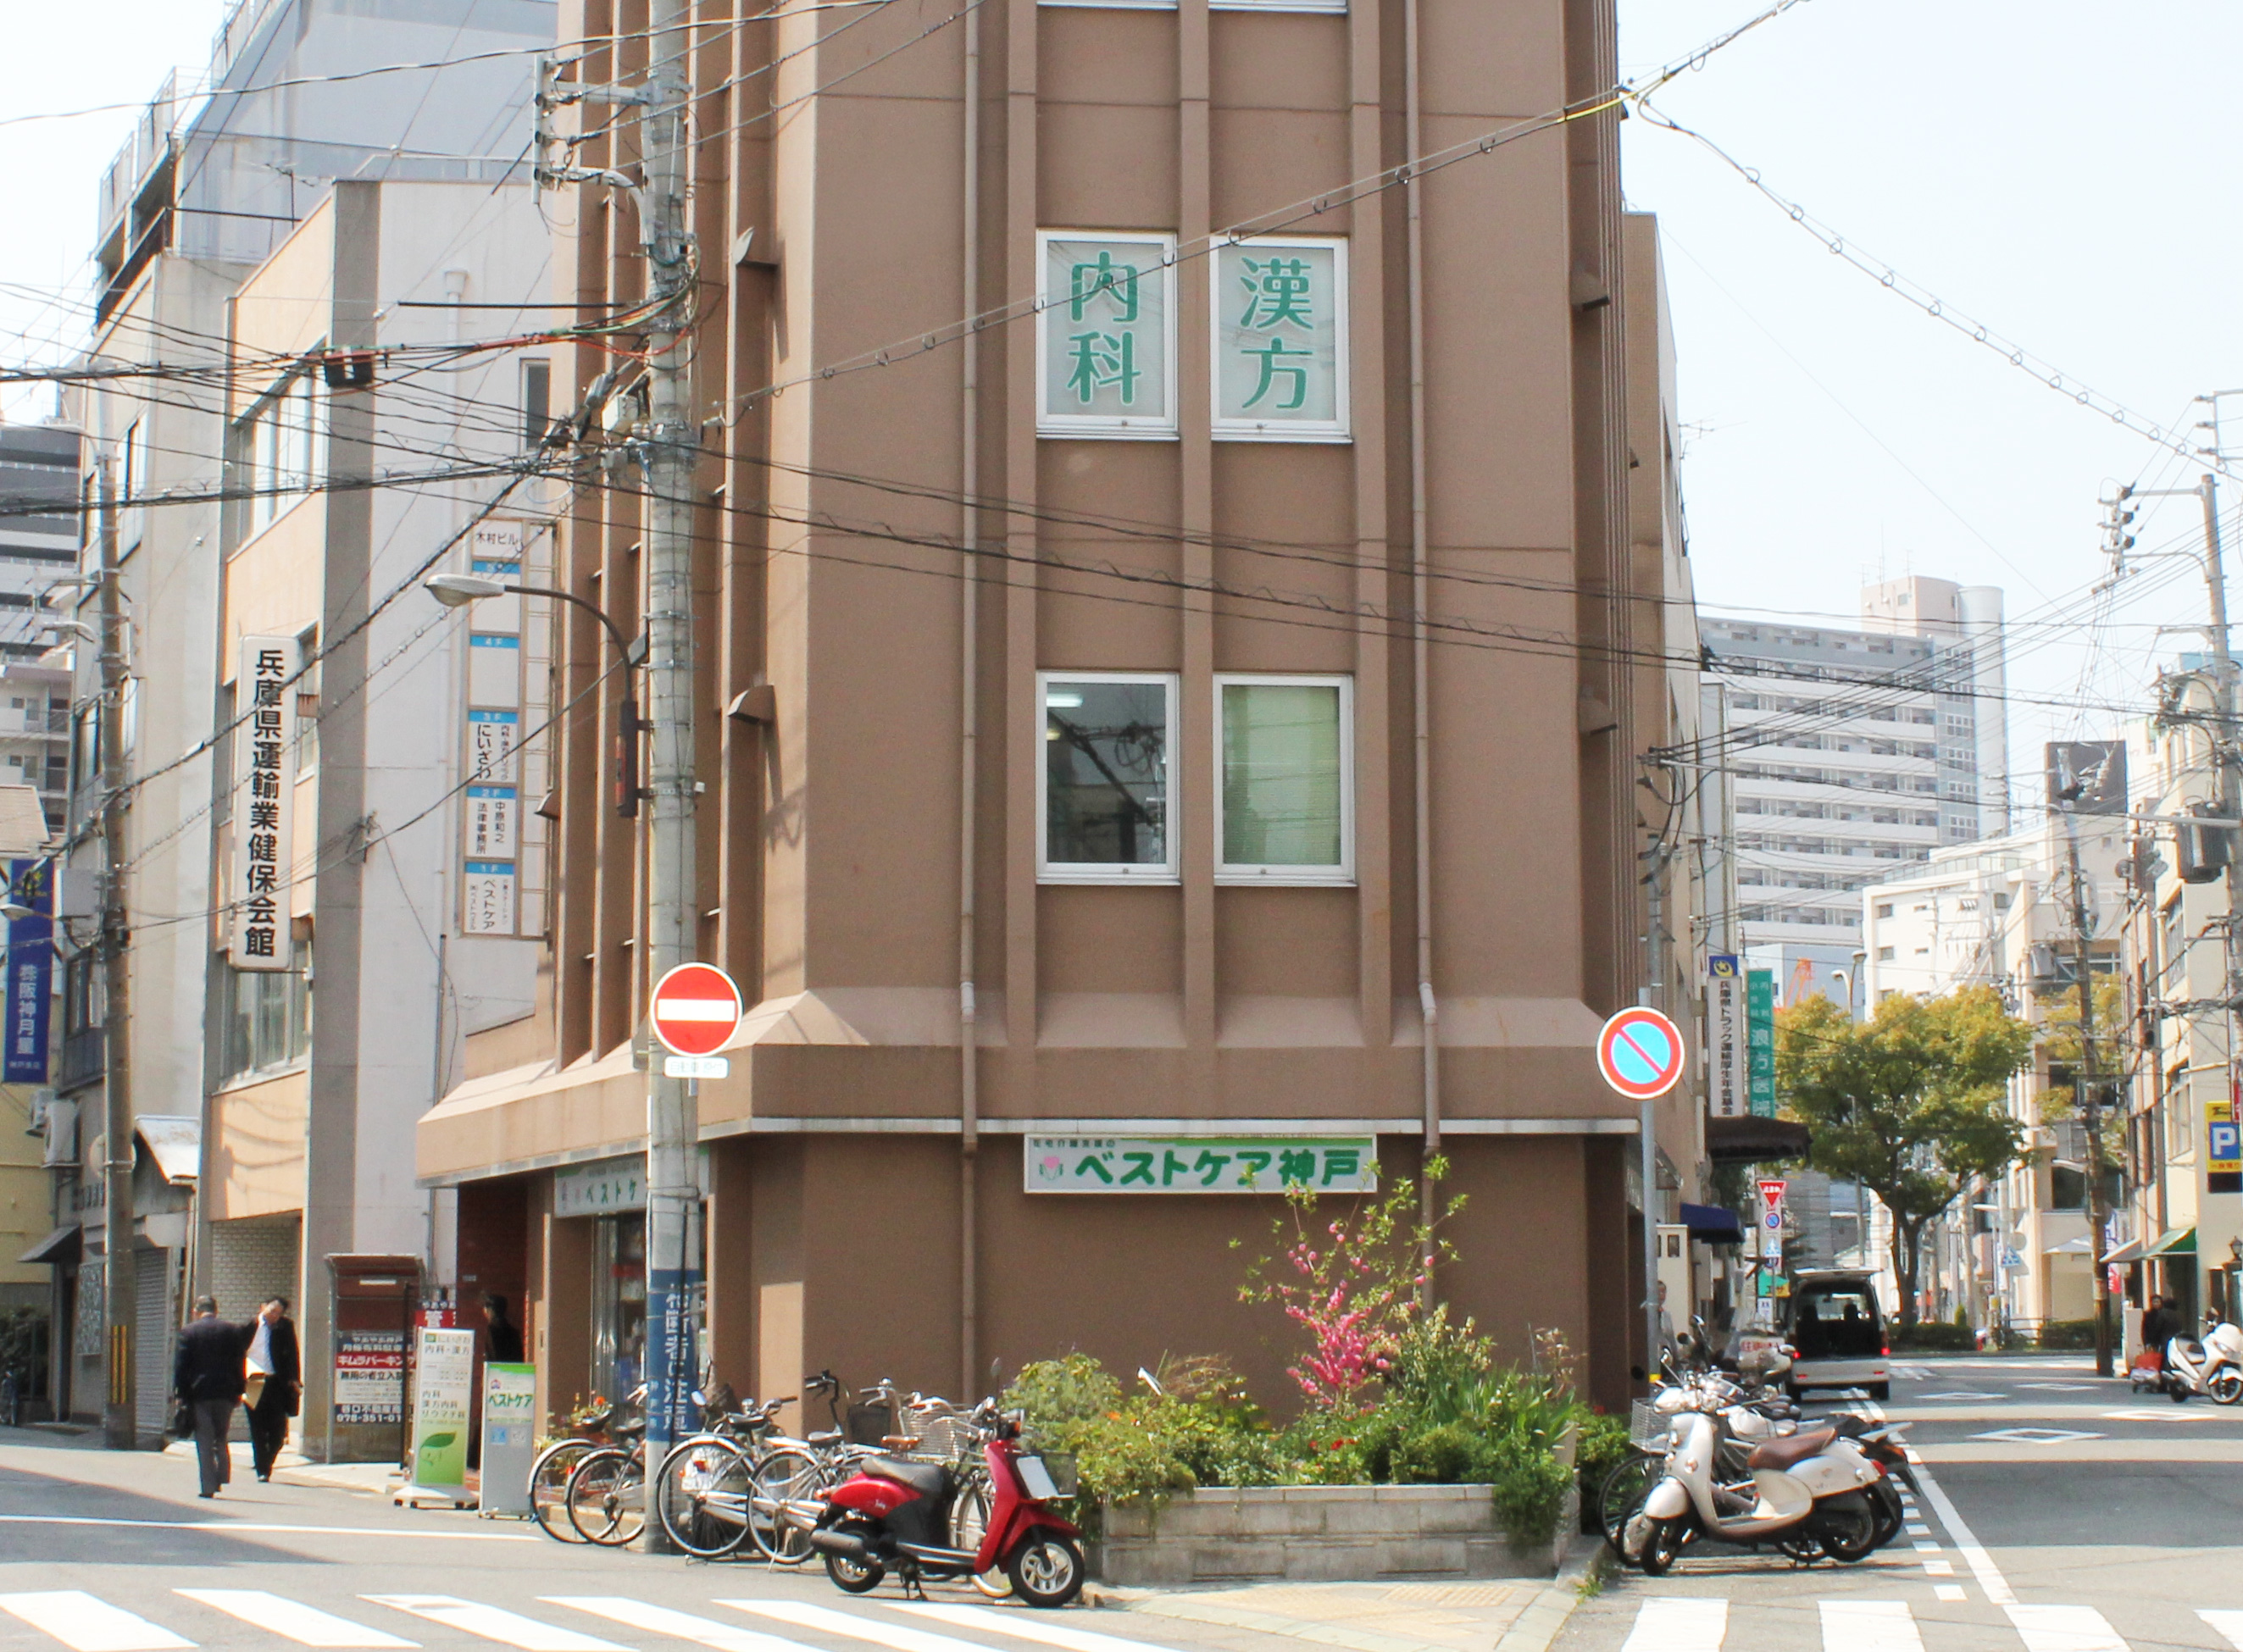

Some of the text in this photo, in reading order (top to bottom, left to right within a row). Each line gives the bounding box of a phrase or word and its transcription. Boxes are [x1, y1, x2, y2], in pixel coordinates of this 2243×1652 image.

[1066, 251, 1141, 405] 内科
[1239, 257, 1313, 409] 漢方
[475, 532, 516, 545] 木村ビル
[246, 649, 284, 956] 兵庫県運輸業健保会館
[484, 879, 496, 929] ベストケア
[2212, 1127, 2236, 1155] P
[1074, 1149, 1360, 1186] ベストケア神戸
[489, 1393, 534, 1408] ベストケア
